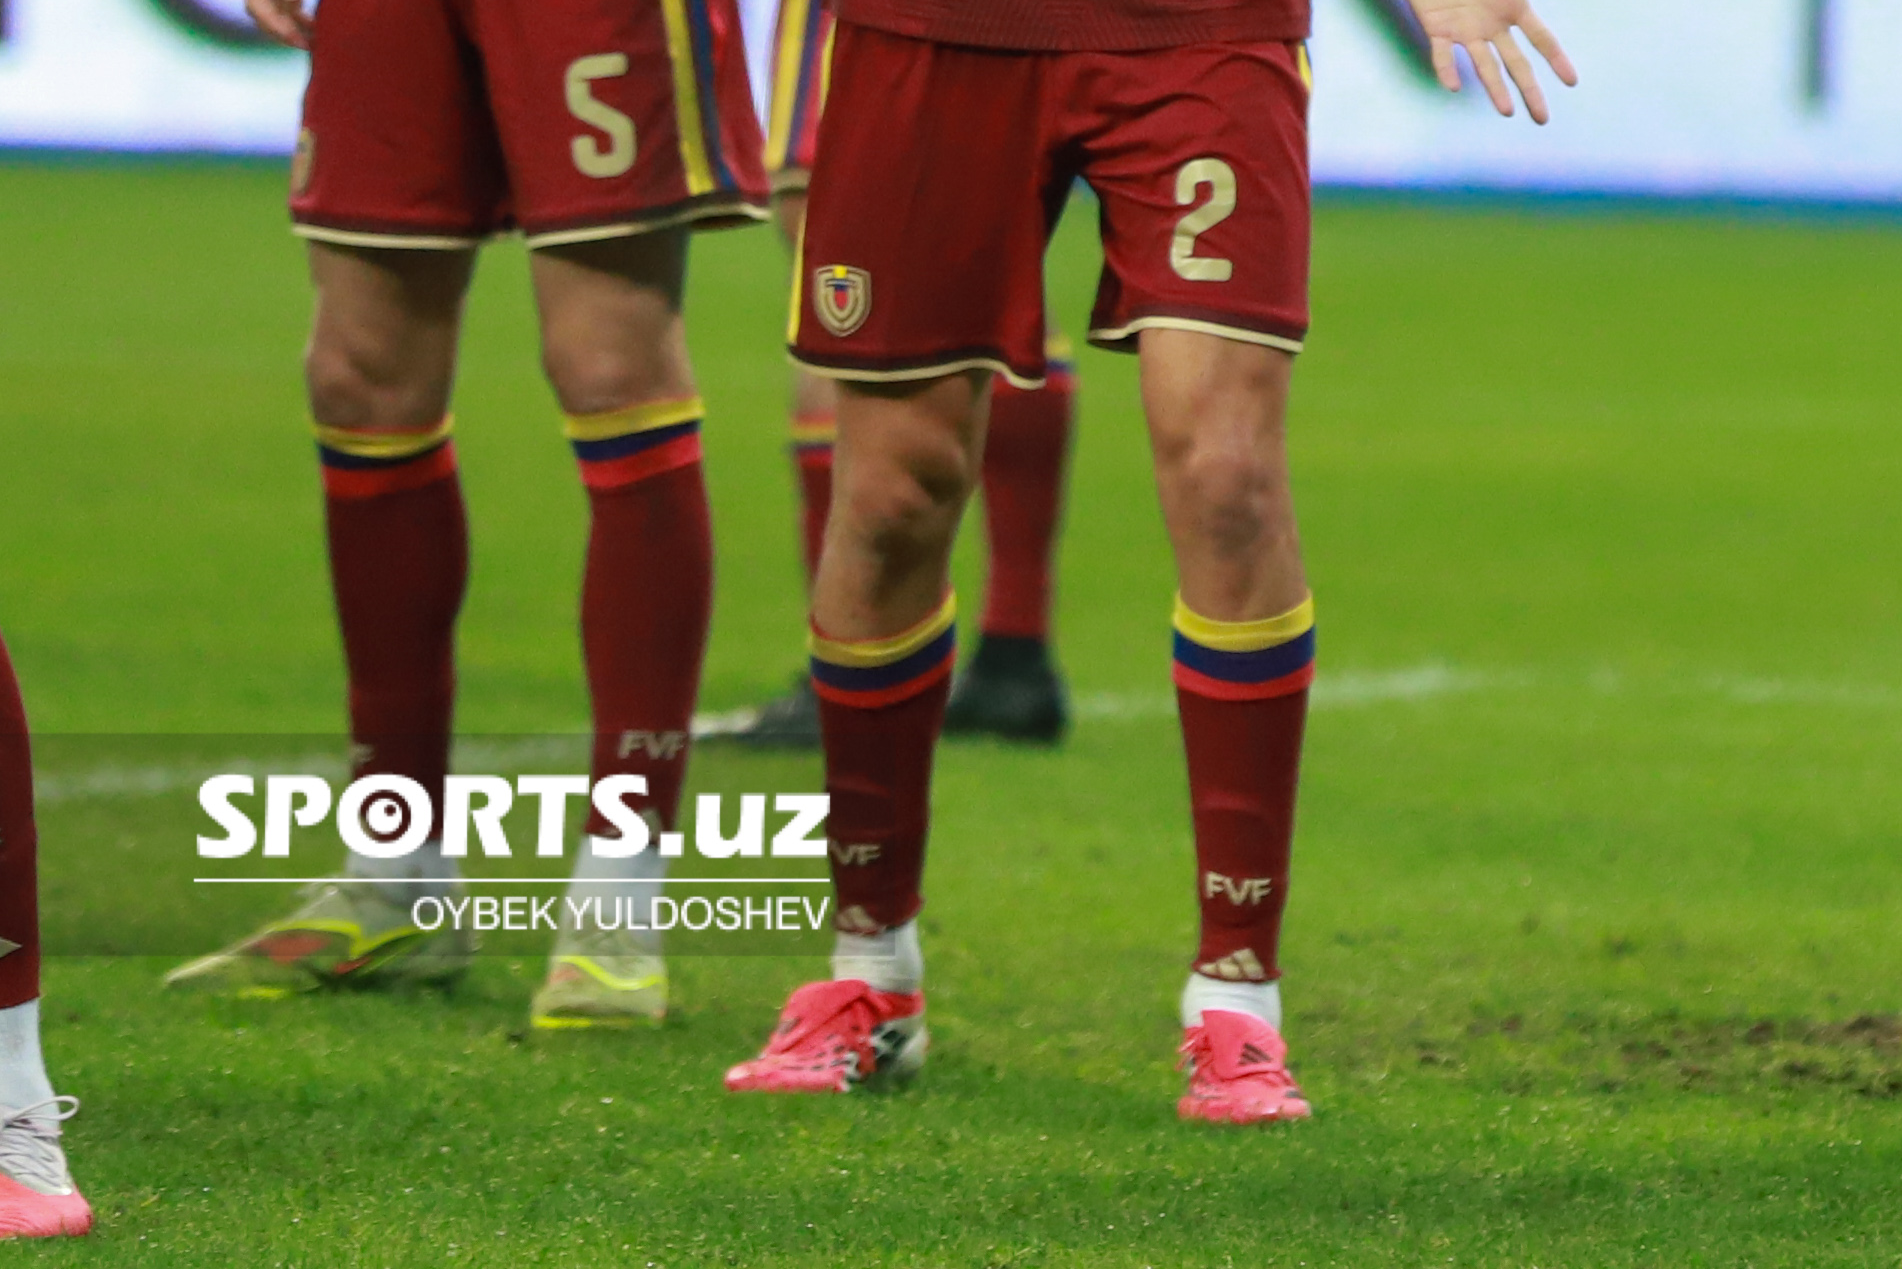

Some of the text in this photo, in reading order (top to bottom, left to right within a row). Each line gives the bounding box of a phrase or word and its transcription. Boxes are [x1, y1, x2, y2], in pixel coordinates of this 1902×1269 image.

[565, 53, 636, 178] 5
[1169, 158, 1238, 282] 2
[828, 840, 881, 866] VF
[1204, 870, 1273, 906] FVF
